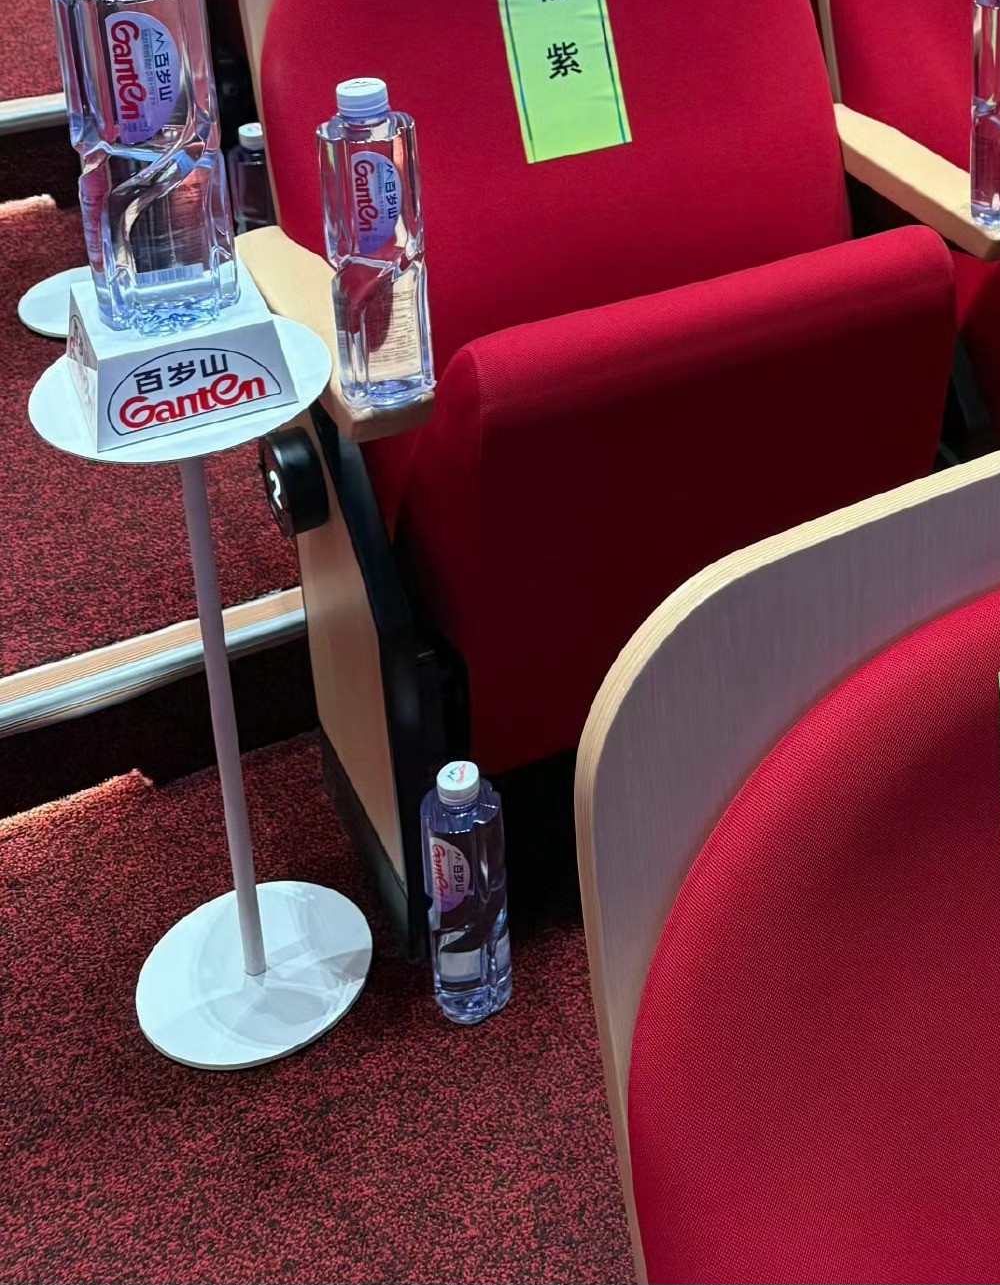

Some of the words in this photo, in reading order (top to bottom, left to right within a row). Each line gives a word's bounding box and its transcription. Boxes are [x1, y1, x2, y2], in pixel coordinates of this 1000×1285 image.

[110, 19, 148, 121] Ganten
[154, 52, 173, 102] 百岁山
[353, 159, 379, 232] Ganten
[385, 181, 398, 220] 百岁山
[133, 353, 229, 395] 百岁山
[118, 373, 267, 429] Ganten
[453, 864, 465, 893] 百岁山
